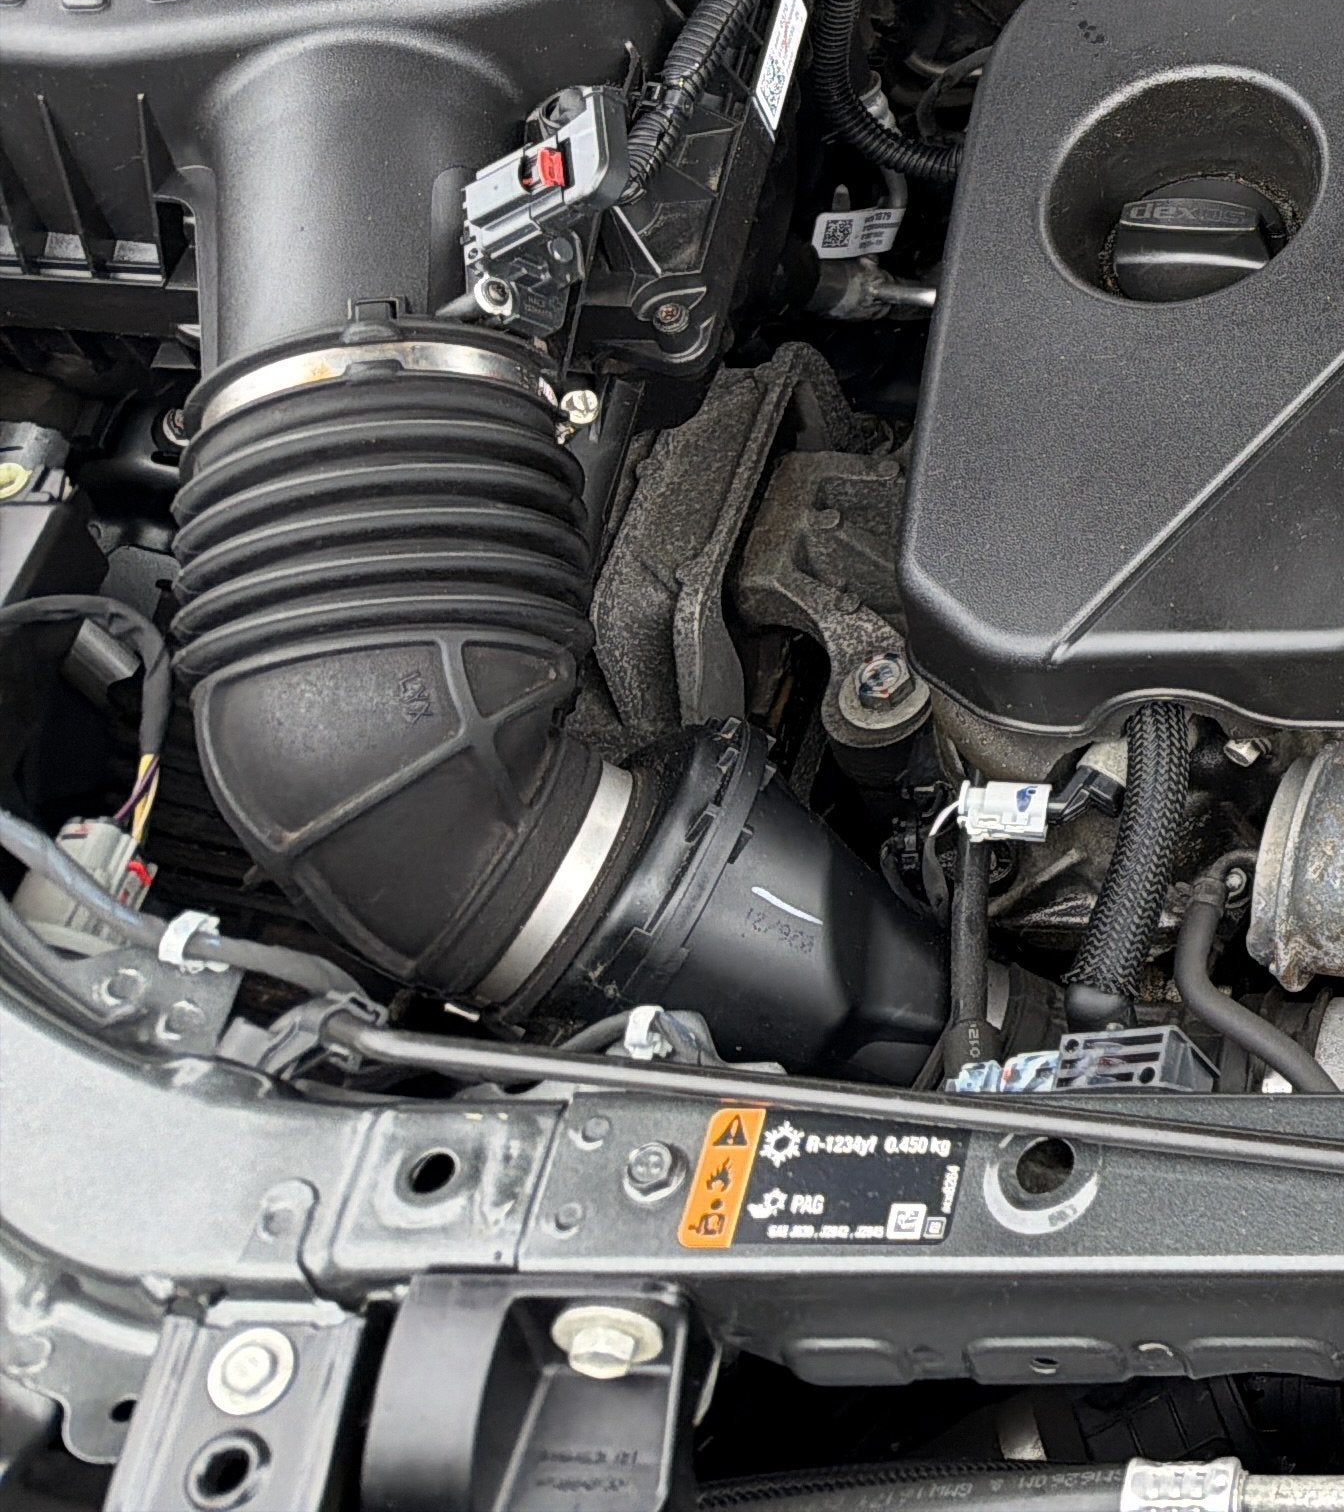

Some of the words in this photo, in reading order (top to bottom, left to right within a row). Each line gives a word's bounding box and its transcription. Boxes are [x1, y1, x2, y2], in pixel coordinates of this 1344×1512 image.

[1129, 201, 1248, 225] dexos
[805, 1135, 879, 1157] R-1234yf
[884, 1136, 928, 1155] 0.450
[930, 1136, 952, 1157] kg
[790, 1194, 825, 1215] PAG
